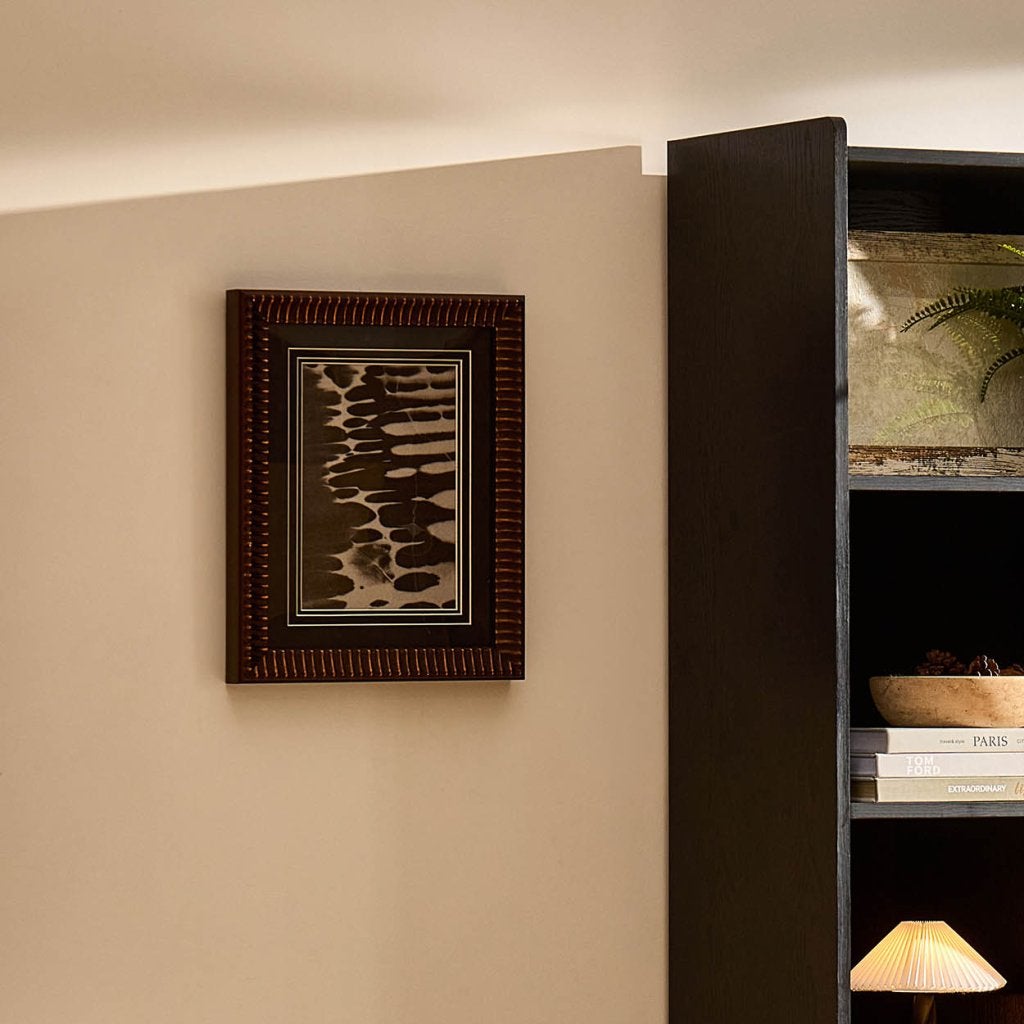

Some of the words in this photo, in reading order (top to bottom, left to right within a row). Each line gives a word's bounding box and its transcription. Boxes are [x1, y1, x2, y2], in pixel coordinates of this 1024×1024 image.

[973, 736, 1008, 747] PARIS
[905, 756, 934, 766] TOM
[906, 765, 941, 776] FORD
[947, 784, 1007, 793] EXTRAORDINARY
